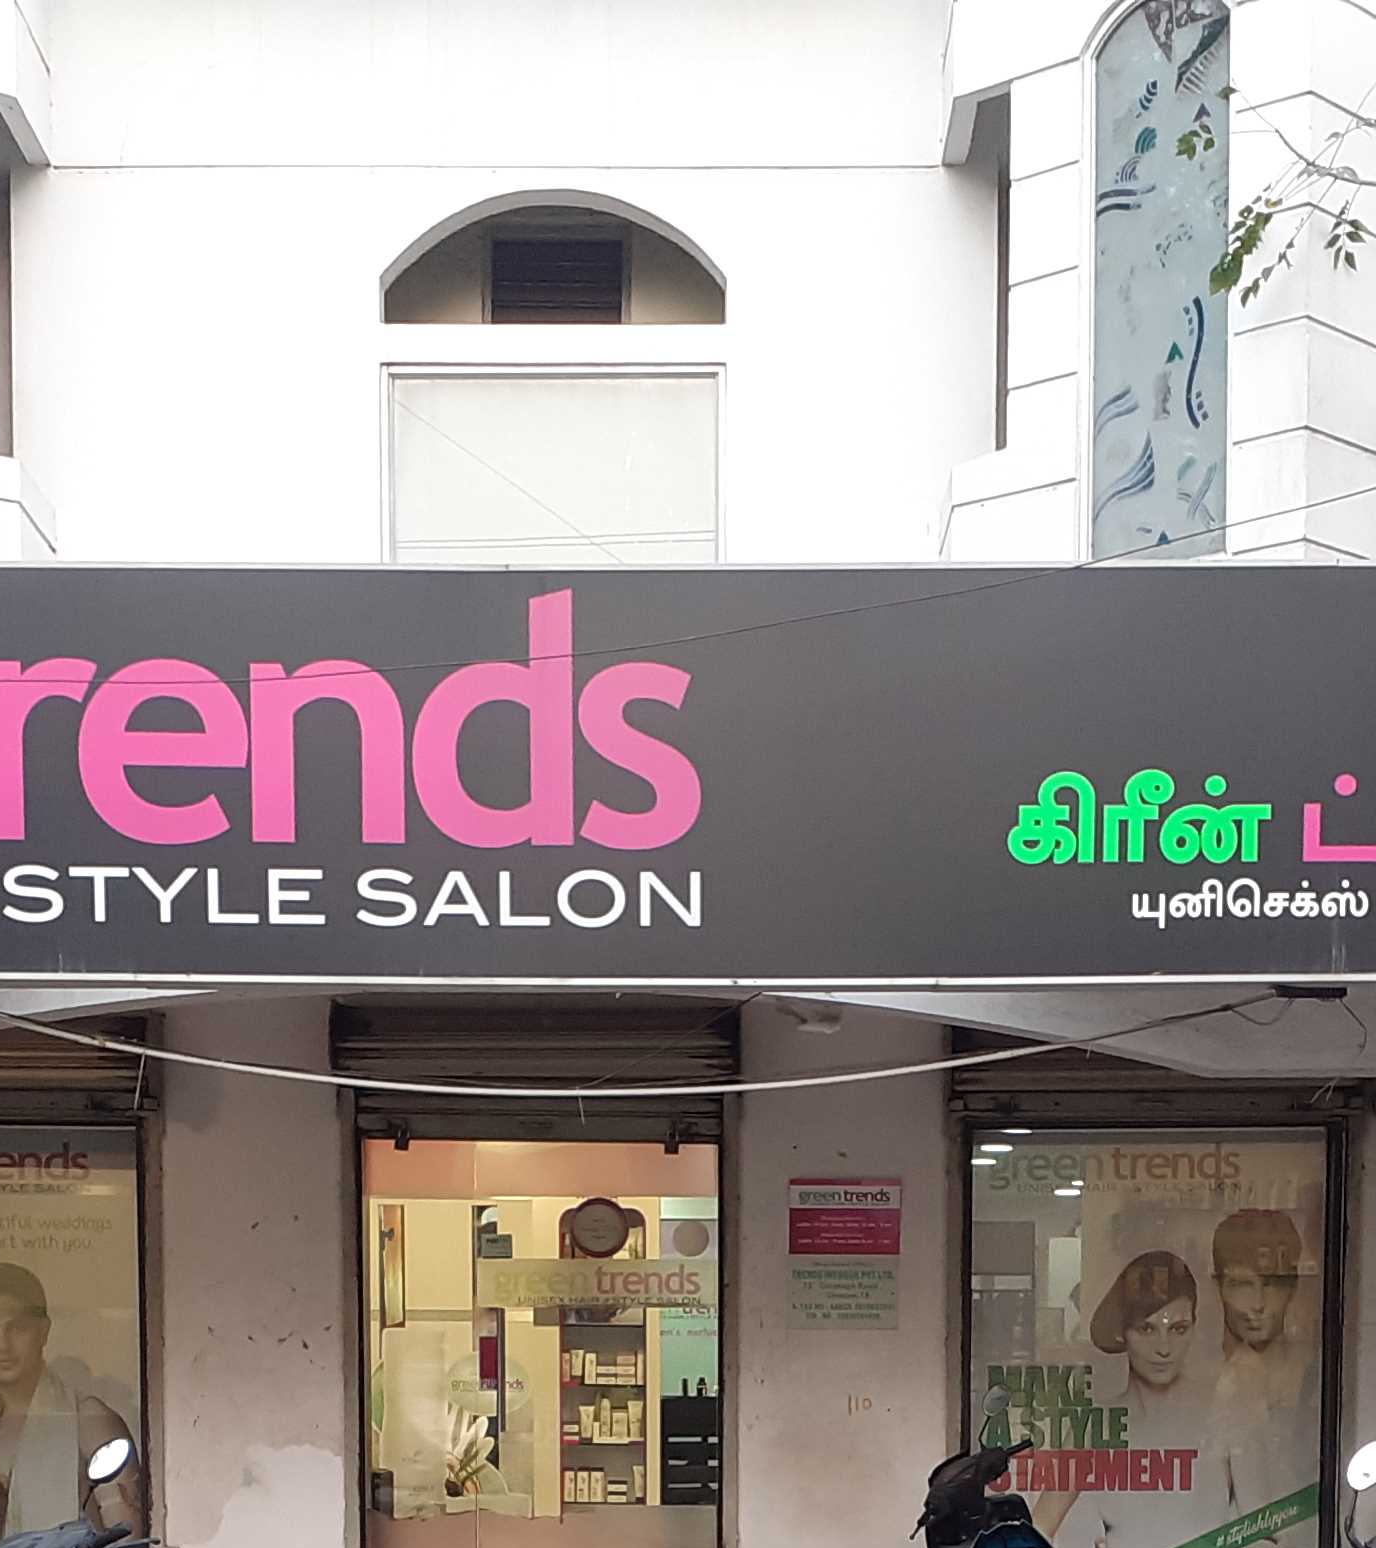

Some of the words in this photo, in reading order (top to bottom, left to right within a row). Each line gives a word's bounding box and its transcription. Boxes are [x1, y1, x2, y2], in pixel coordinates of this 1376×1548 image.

[1007, 769, 1273, 865] கிரீன்
[3, 867, 326, 925] STYLE
[356, 868, 702, 928] SALON
[1132, 877, 1369, 929] யுனிசெக்ஸ்
[1112, 1143, 1241, 1181] trends
[798, 1190, 841, 1206] green
[843, 1187, 891, 1203] trends
[594, 1264, 701, 1296] trends
